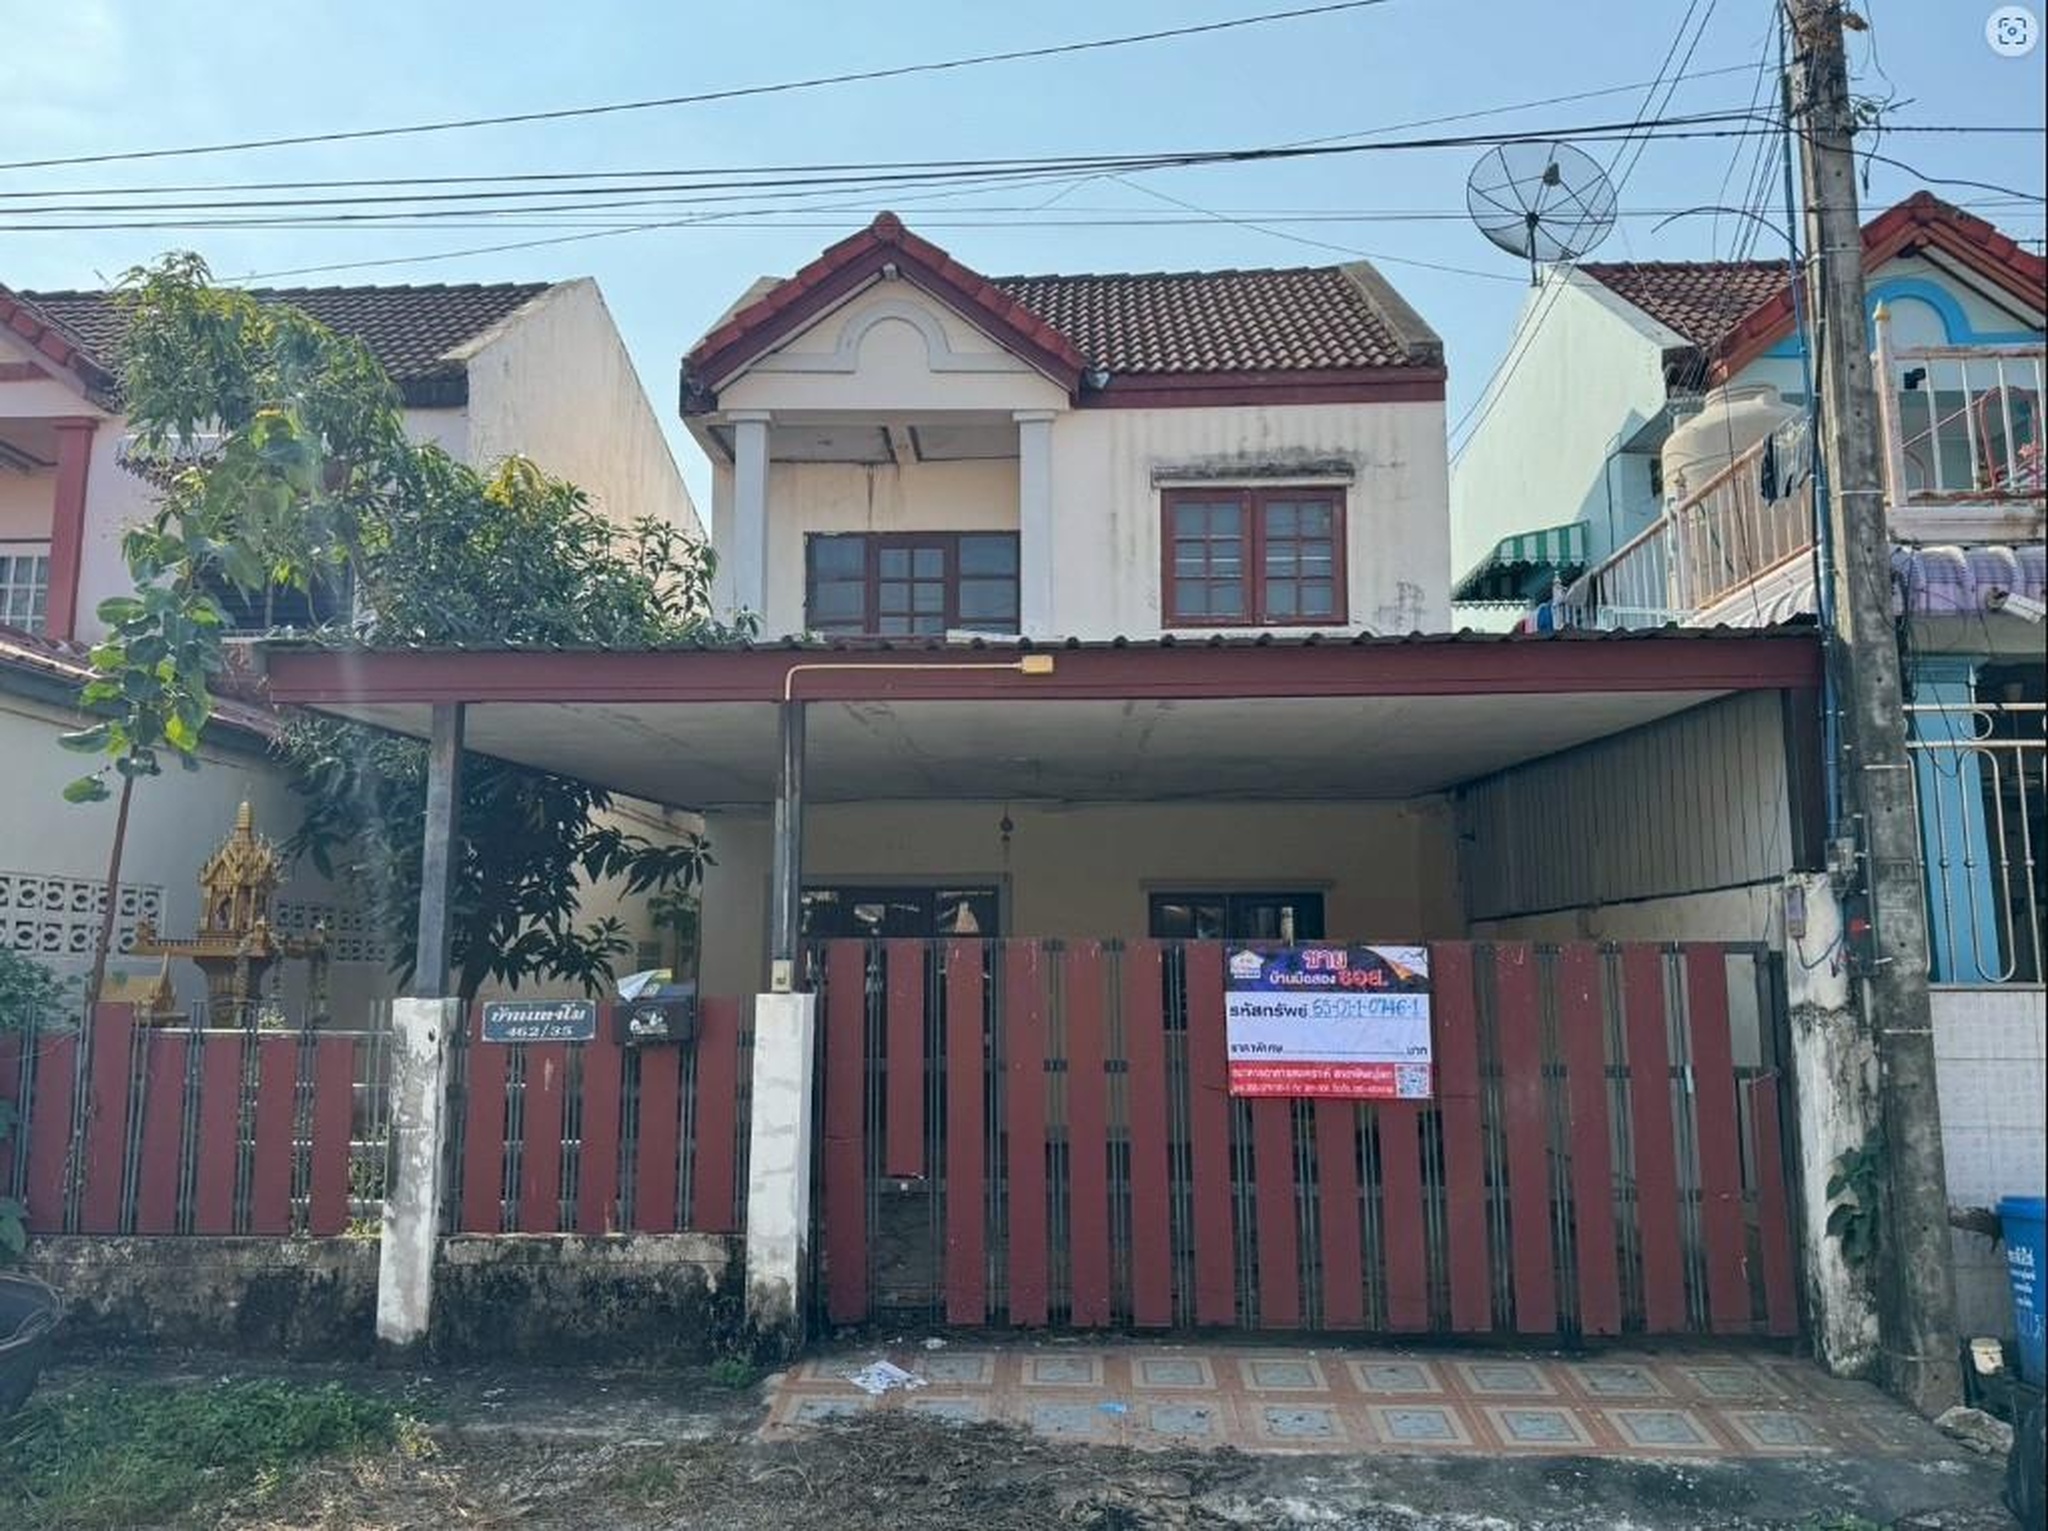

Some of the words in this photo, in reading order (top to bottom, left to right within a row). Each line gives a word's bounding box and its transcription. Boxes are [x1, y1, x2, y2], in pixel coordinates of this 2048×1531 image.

[1302, 949, 1348, 970] ขาย
[1269, 969, 1336, 985] บ้านมือสอง
[1229, 1002, 1308, 1018] รหัสทรัพย์
